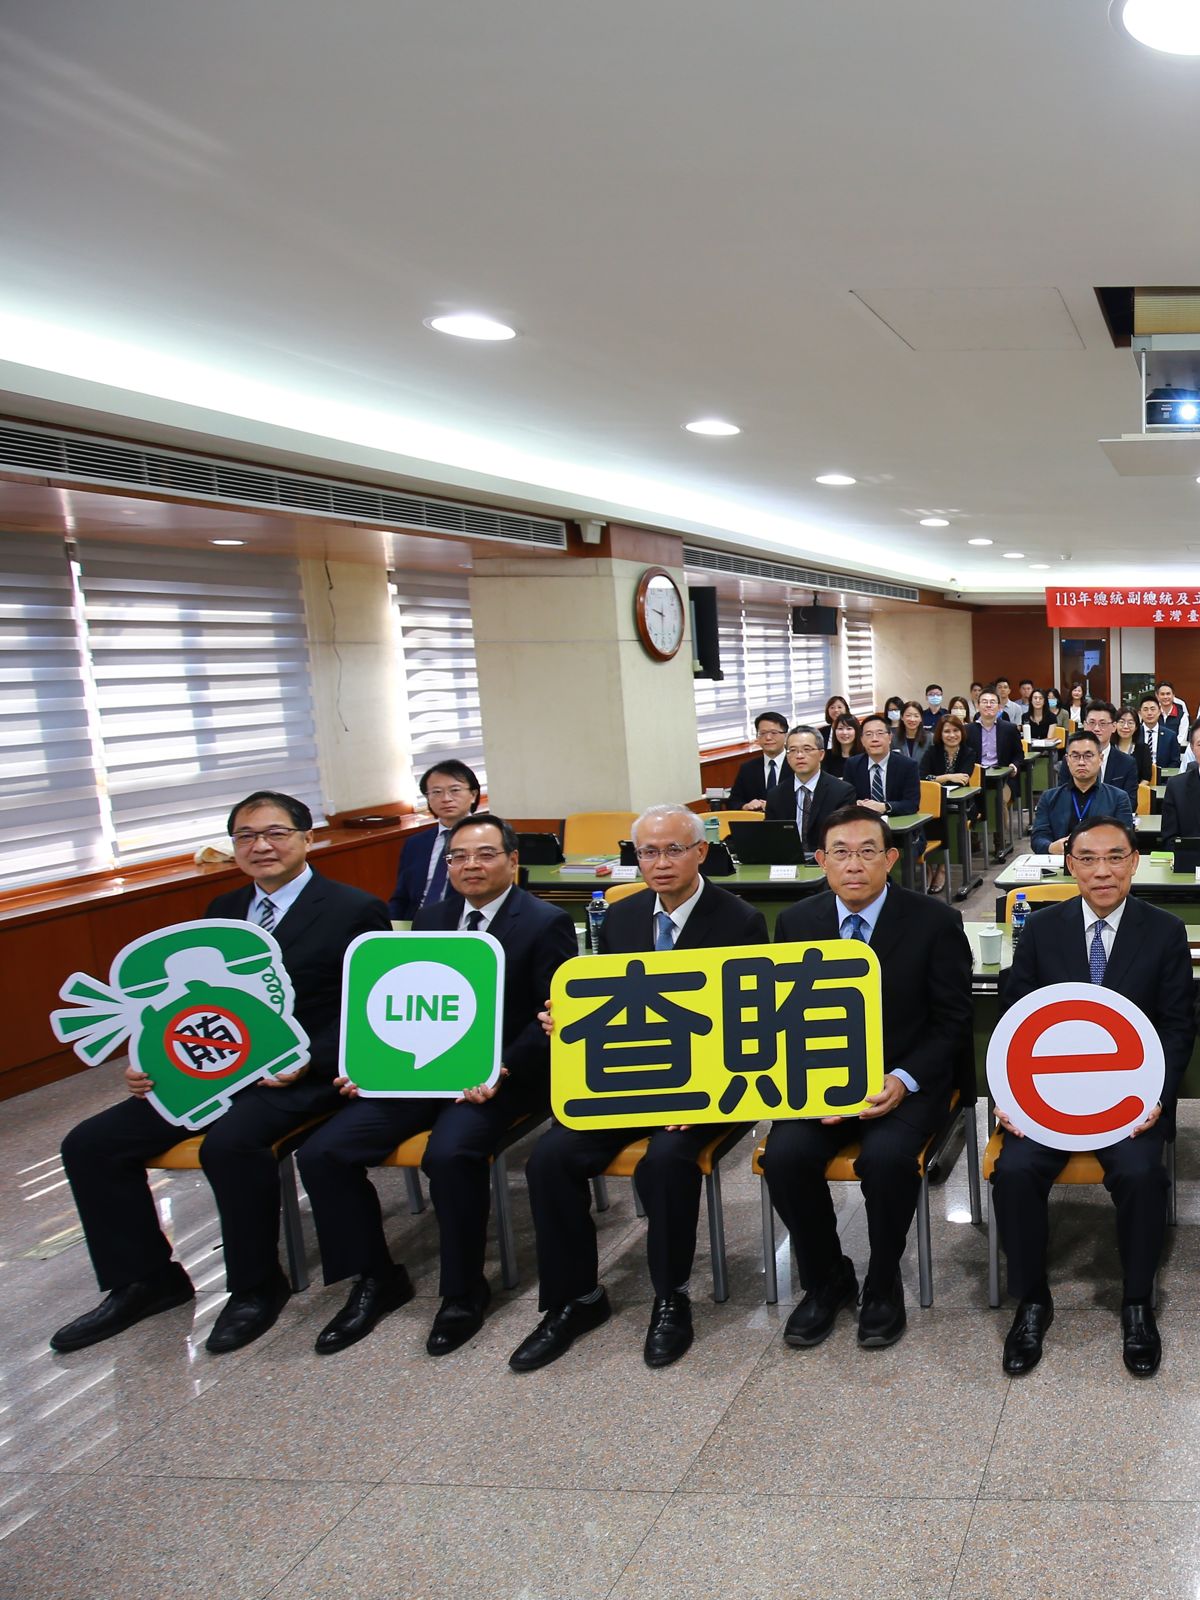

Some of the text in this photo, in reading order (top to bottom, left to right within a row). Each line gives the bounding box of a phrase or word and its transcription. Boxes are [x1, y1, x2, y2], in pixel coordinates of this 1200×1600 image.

[385, 994, 459, 1022] LINE
[560, 947, 870, 1118] 查賄
[1006, 1000, 1145, 1136] e
